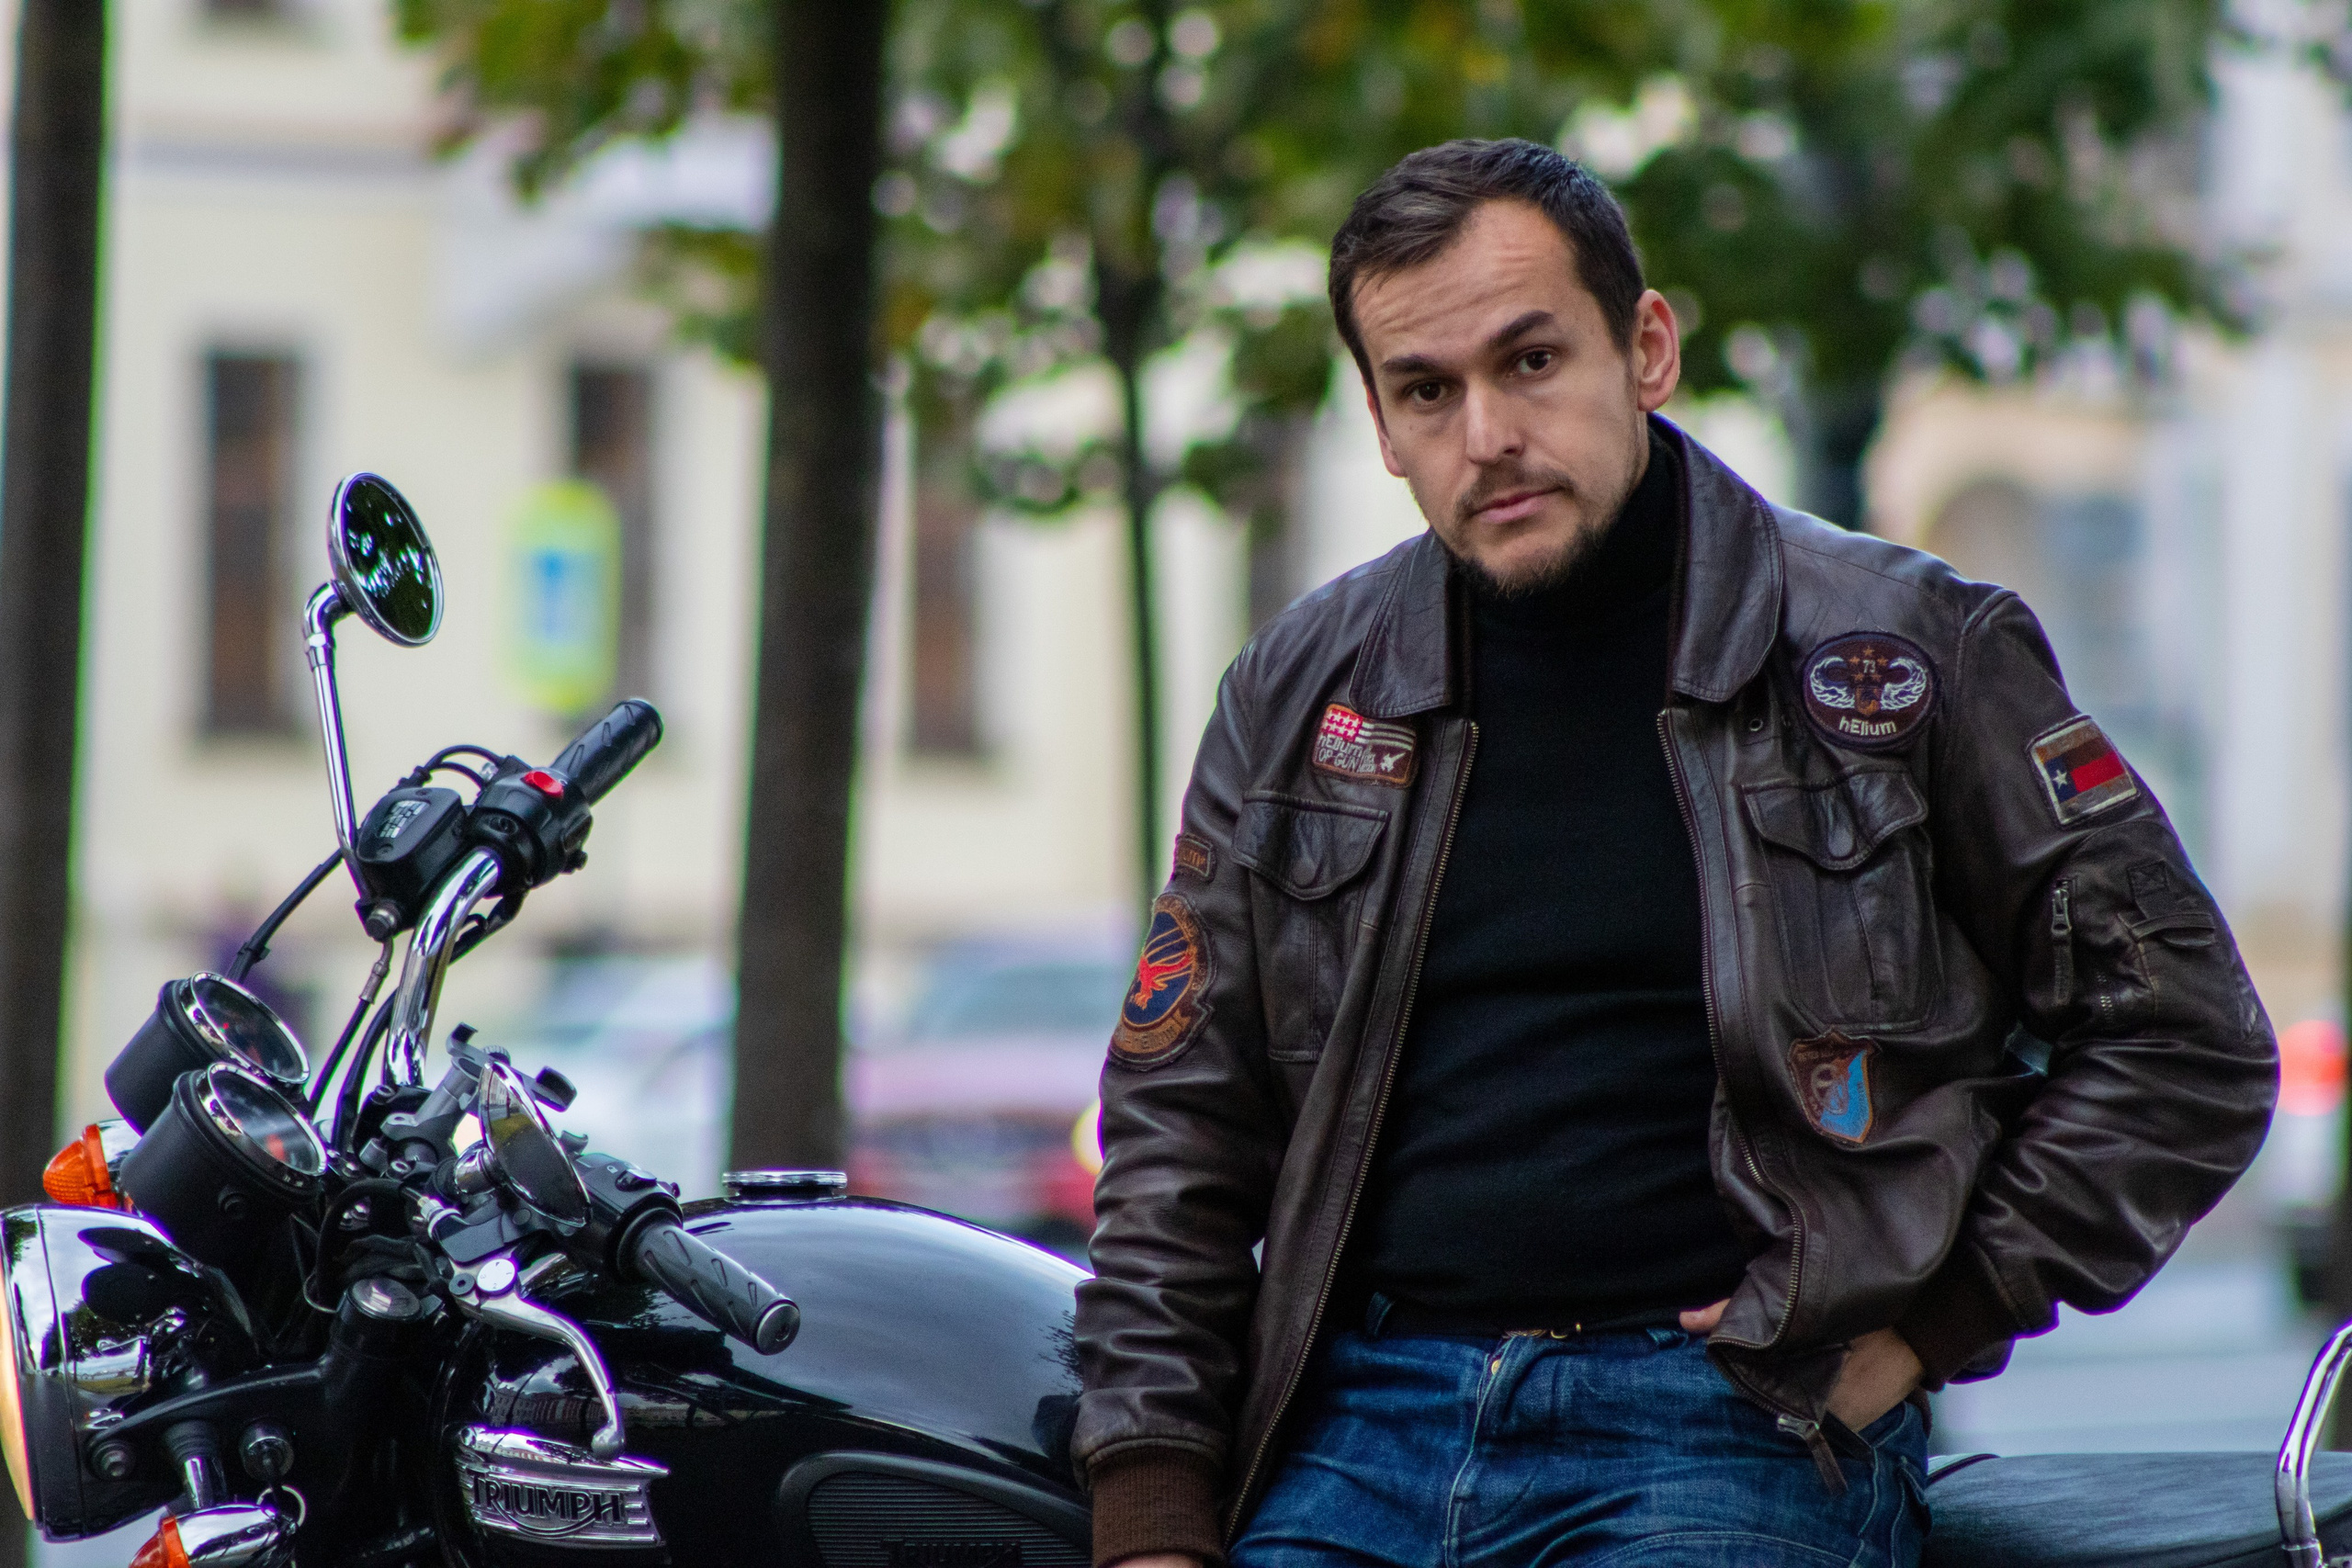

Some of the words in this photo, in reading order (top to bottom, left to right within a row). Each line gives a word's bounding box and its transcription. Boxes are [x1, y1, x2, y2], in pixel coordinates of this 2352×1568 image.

[1862, 660, 1876, 674] 73
[1334, 751, 1361, 773] GUN
[468, 1470, 624, 1532] TRIUMPH
